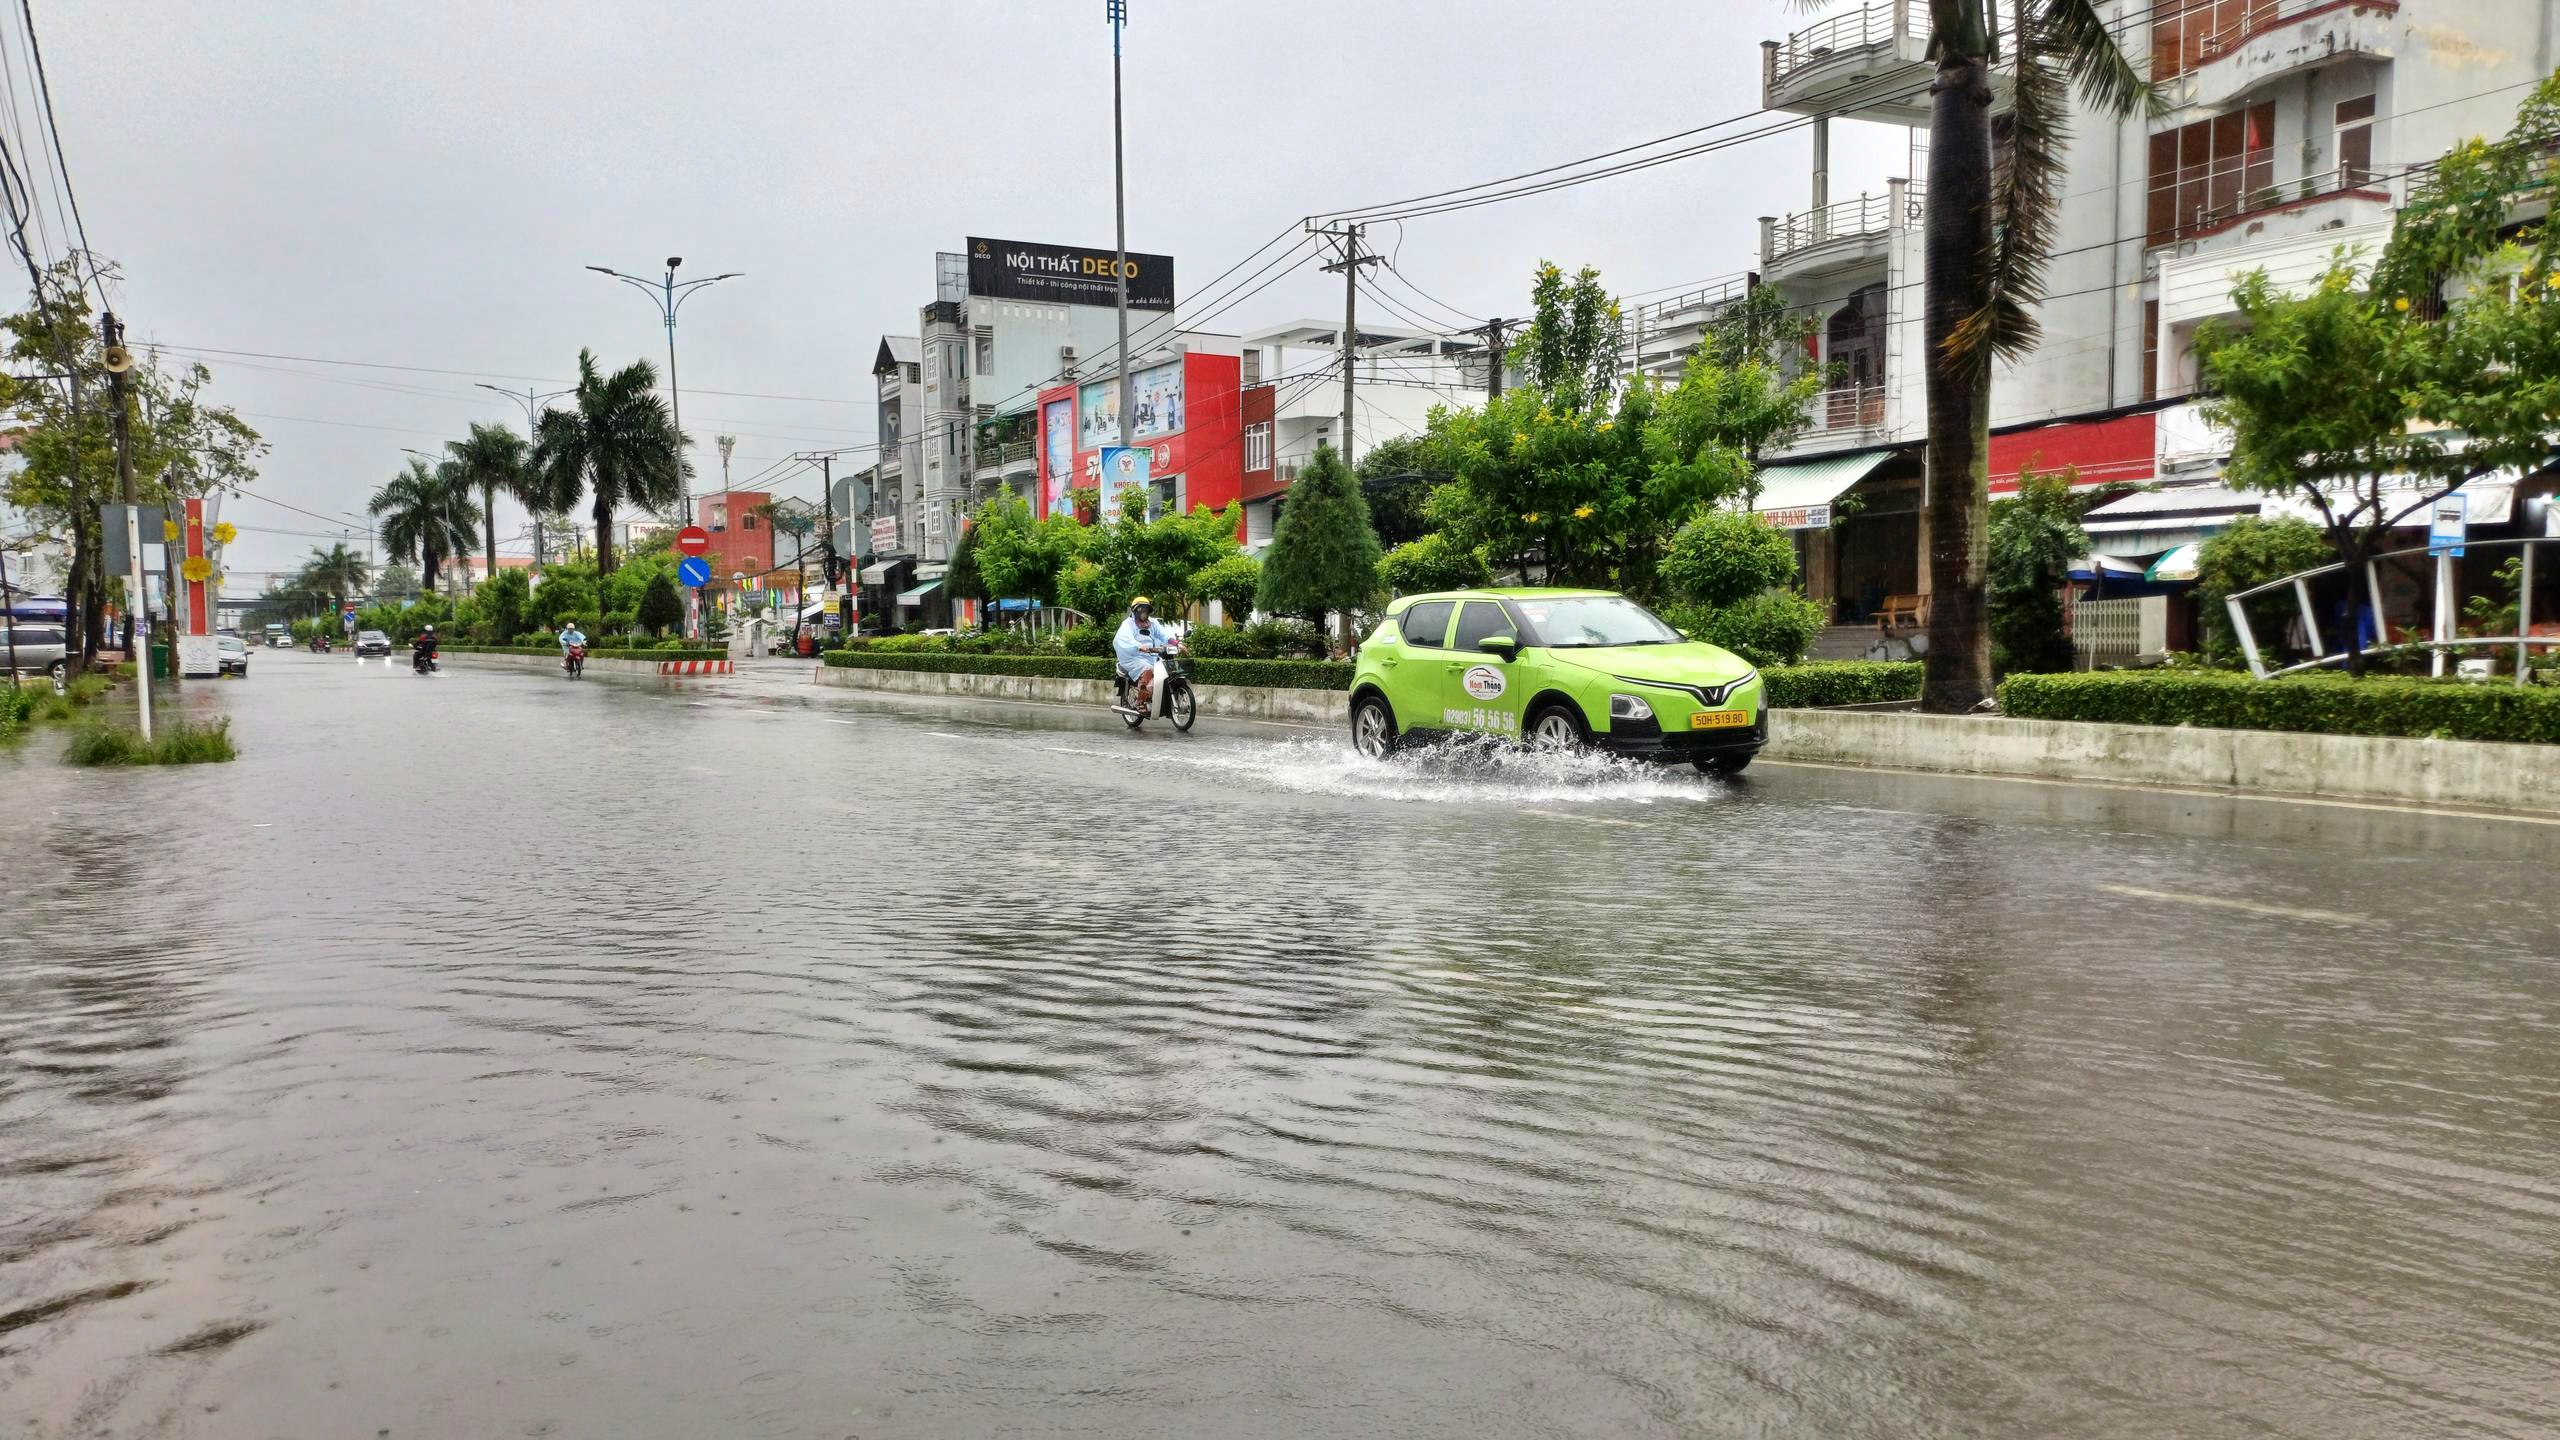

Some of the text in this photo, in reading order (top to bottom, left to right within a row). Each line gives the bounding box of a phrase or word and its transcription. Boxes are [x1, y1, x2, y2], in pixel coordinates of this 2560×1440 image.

[1006, 252, 1034, 271] NỘI
[1037, 254, 1079, 273] THẤT
[1060, 281, 1077, 291] công
[1469, 680, 1483, 689] Nam
[1443, 707, 1515, 731] (02903) 56 56 56
